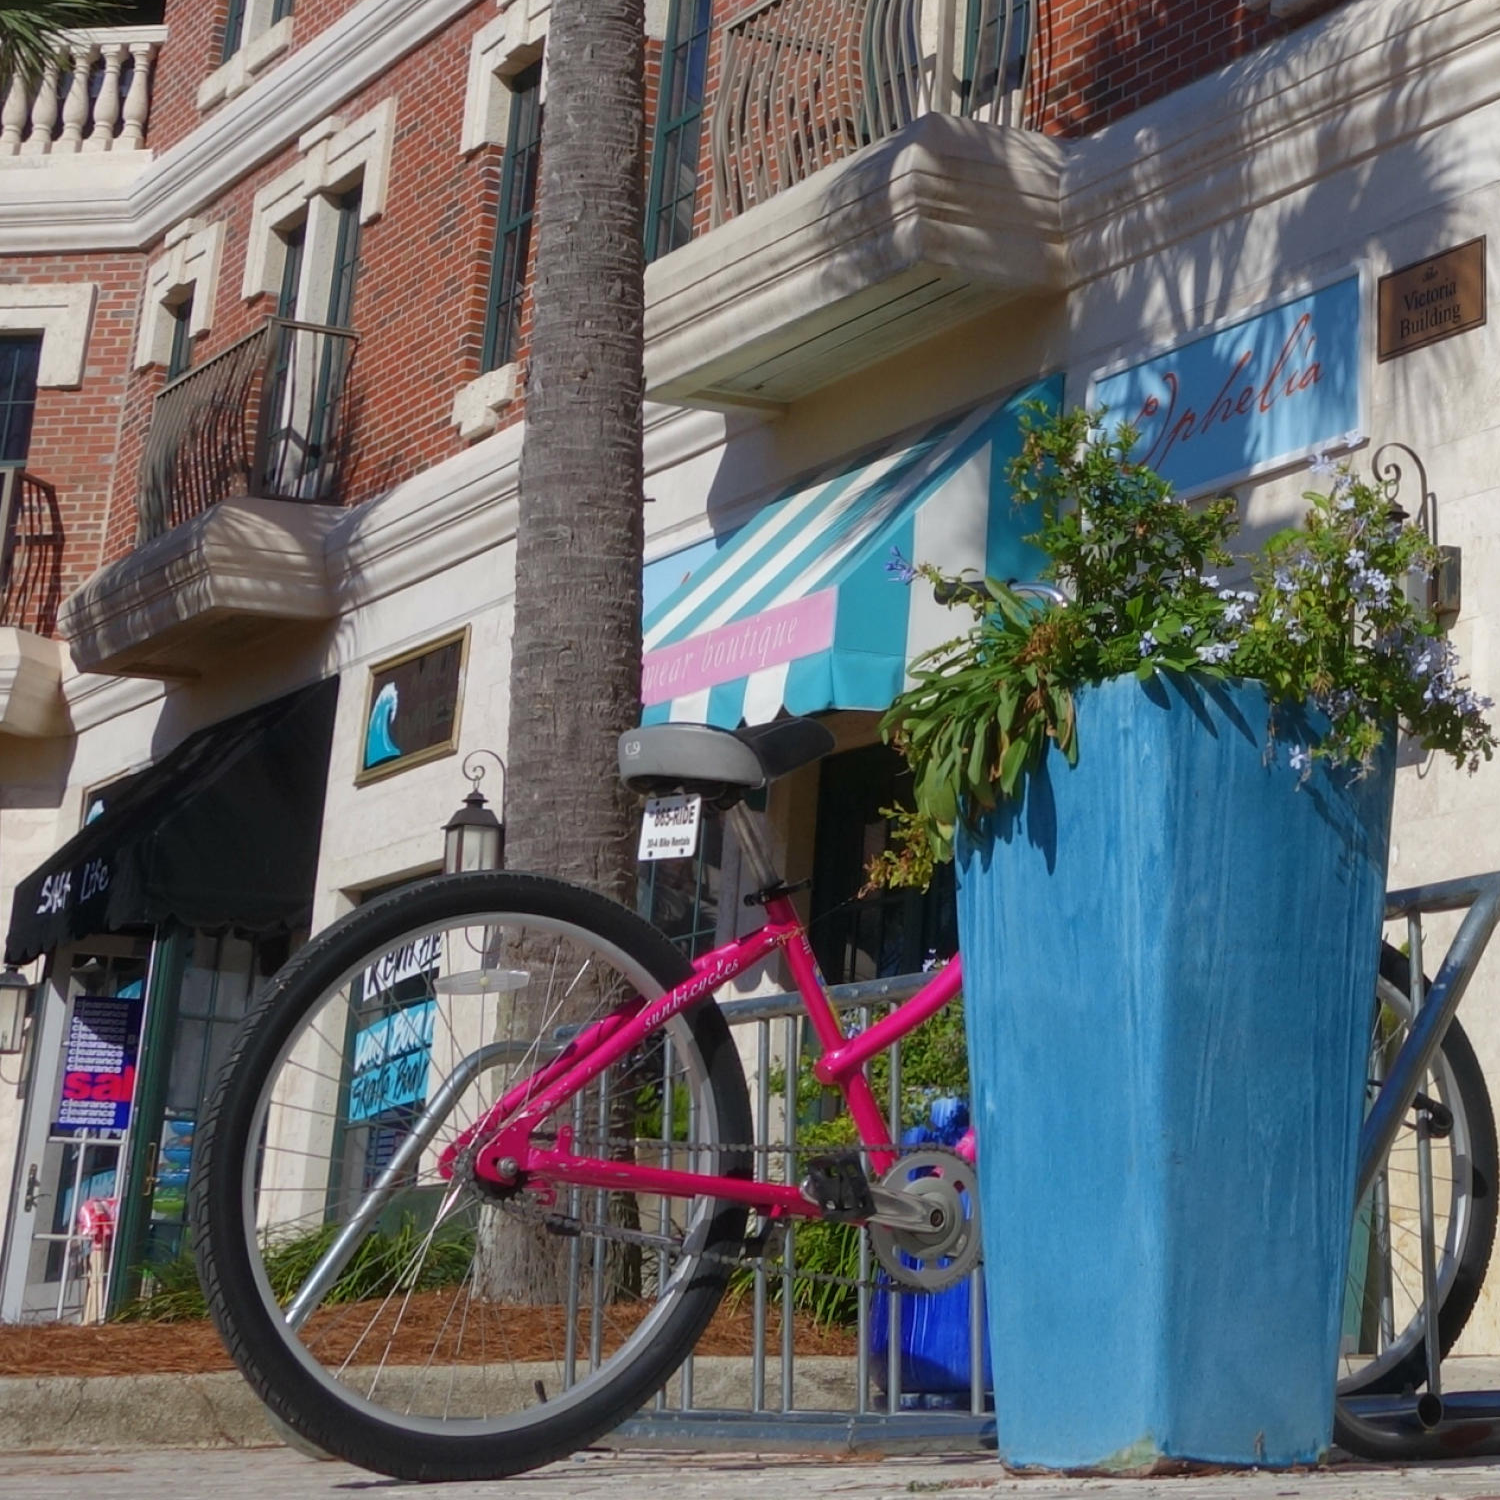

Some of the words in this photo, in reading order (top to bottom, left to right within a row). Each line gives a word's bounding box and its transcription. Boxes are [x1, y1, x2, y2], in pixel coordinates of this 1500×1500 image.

[1404, 277, 1457, 311] Victoria
[1400, 304, 1462, 340] Building
[1122, 312, 1326, 476] Ophelia
[702, 616, 800, 673] boutique
[69, 1049, 124, 1057] clearance
[67, 1056, 123, 1065] clearance
[66, 1064, 122, 1073] clearance
[64, 1066, 135, 1102] sal
[62, 1100, 117, 1109] clearance
[60, 1108, 116, 1117] clearance
[59, 1116, 115, 1125] clearance
